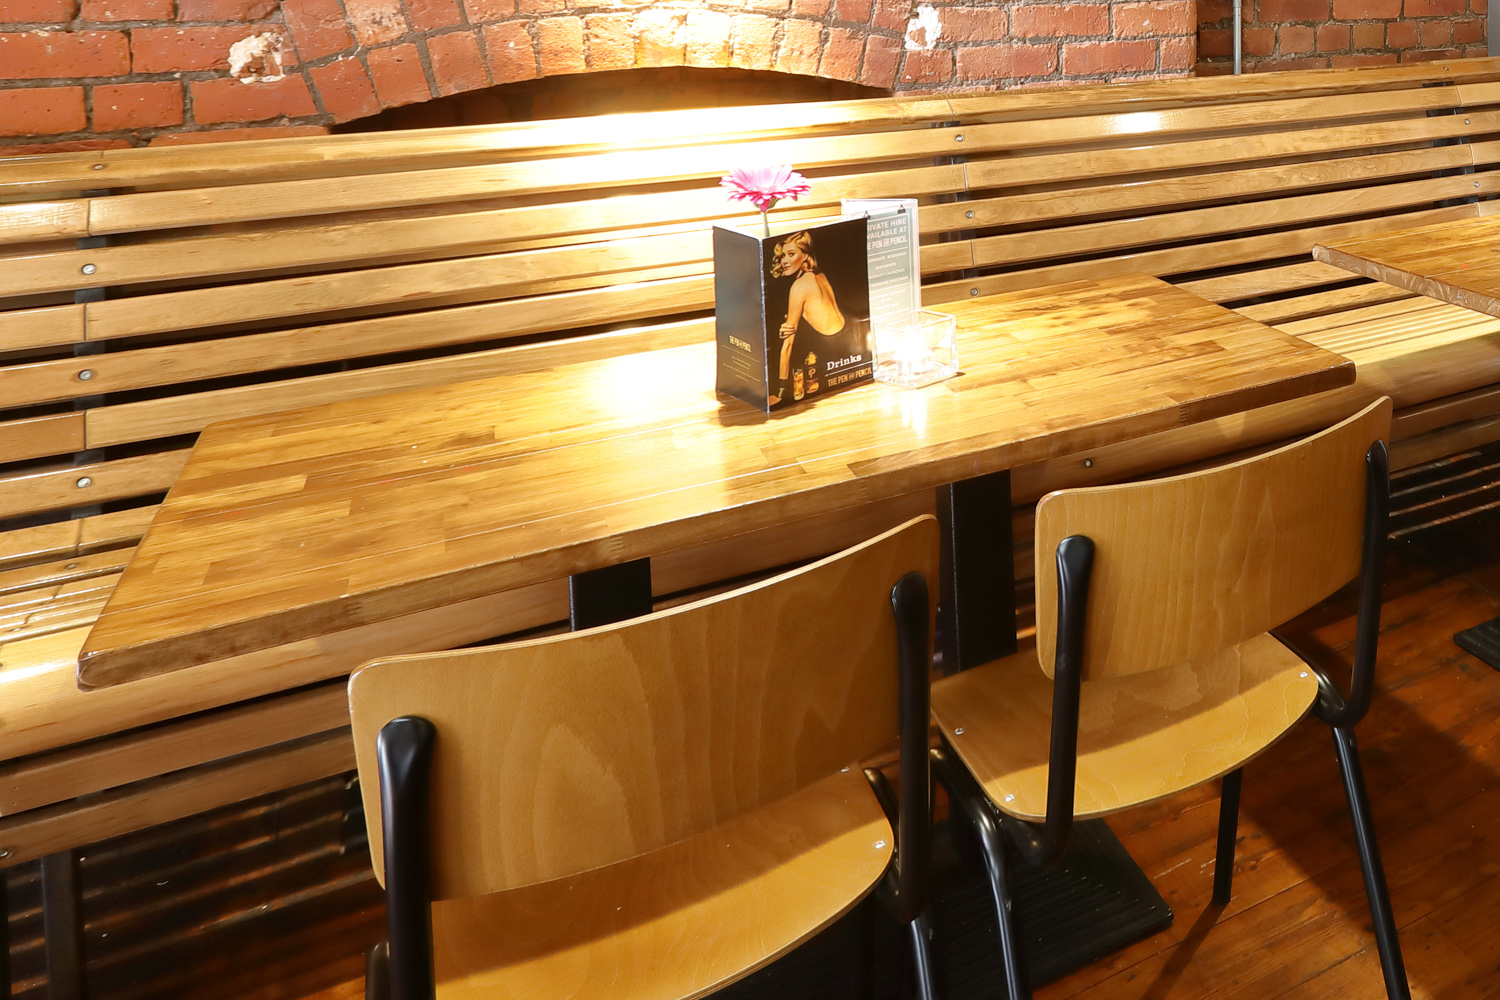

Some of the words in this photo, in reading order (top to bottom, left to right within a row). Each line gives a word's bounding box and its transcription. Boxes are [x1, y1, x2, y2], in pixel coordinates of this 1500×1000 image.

[826, 355, 862, 371] Drinks
[828, 377, 837, 387] THE
[838, 374, 848, 384] PEN
[856, 367, 872, 378] PENCIL
